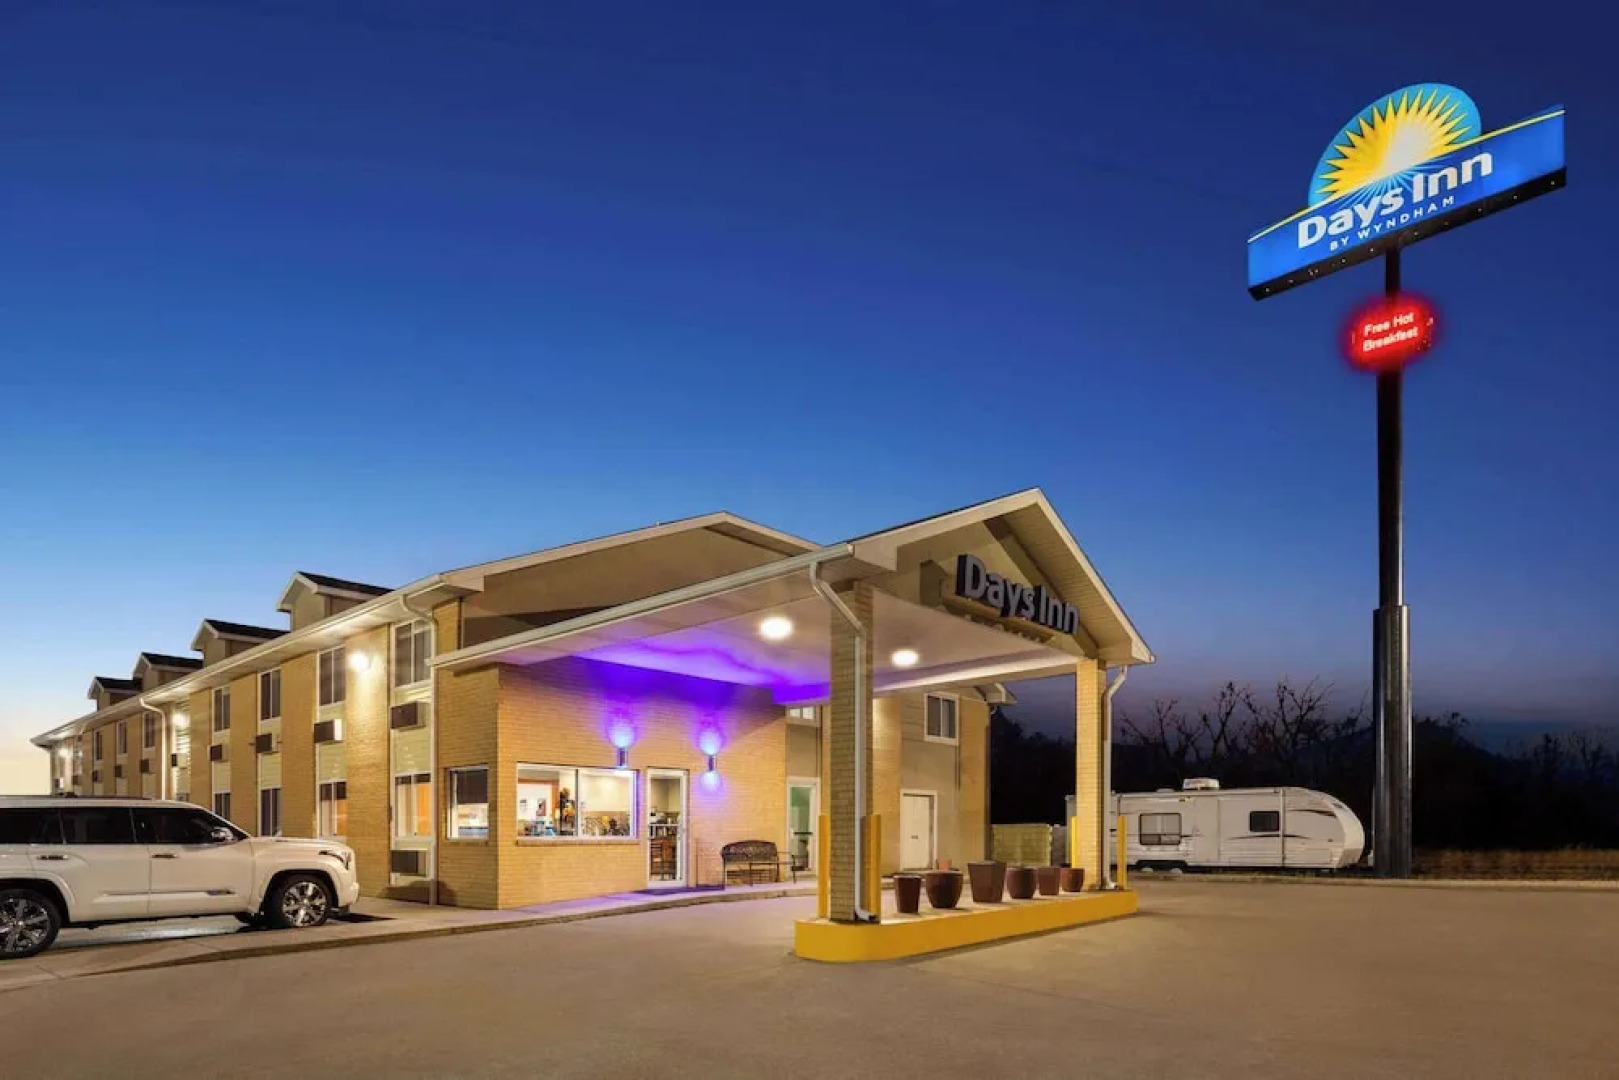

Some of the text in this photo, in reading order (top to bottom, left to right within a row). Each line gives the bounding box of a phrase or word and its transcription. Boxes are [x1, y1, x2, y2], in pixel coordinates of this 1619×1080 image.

[1298, 153, 1493, 249] Days Inn
[1329, 196, 1455, 251] BY WYNDHAM
[1363, 326, 1418, 352] Breakfast
[1364, 312, 1414, 337] Free Hot
[957, 554, 1080, 635] Days Inn
